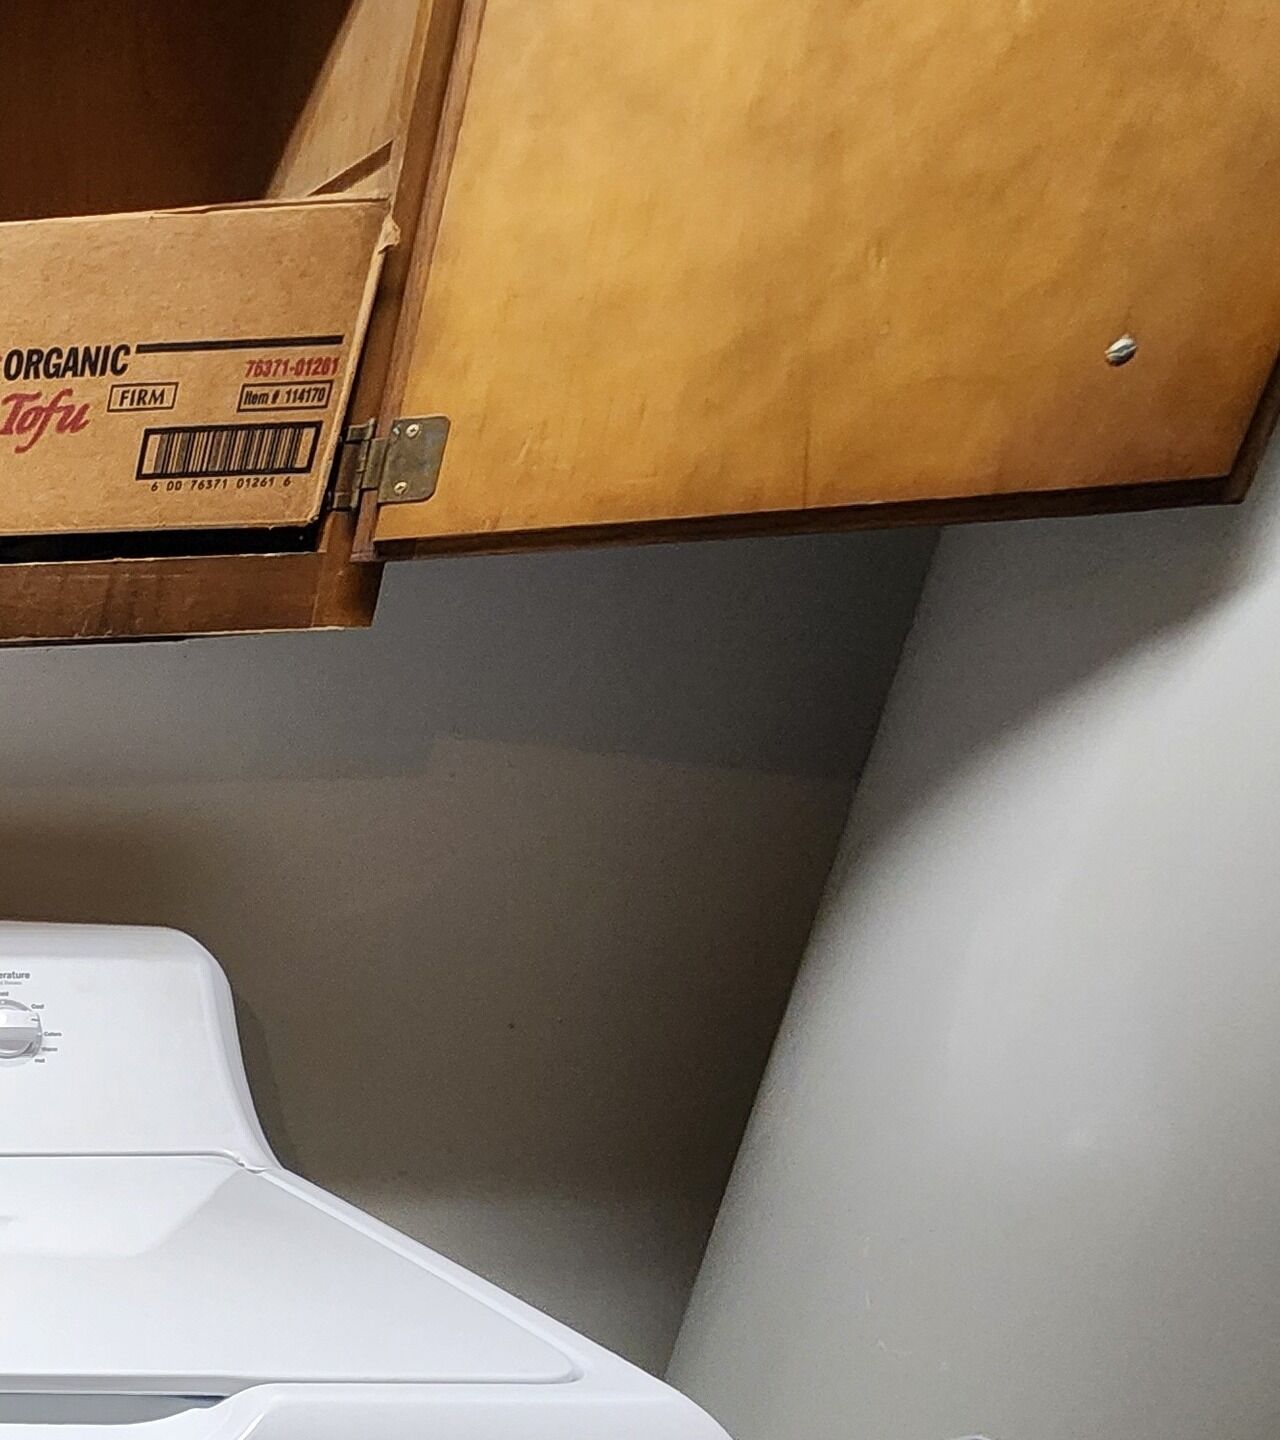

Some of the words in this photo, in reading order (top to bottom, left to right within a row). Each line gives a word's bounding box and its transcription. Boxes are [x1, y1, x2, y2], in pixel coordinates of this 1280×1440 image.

[4, 344, 130, 380] ORGANIC
[245, 357, 340, 377] 76371-01261
[119, 388, 165, 407] FIRM
[243, 391, 270, 405] Item
[284, 387, 325, 404] 114170
[151, 481, 158, 492] 6
[191, 478, 228, 490] 76371
[236, 477, 275, 489] 01261
[283, 476, 291, 487] 6
